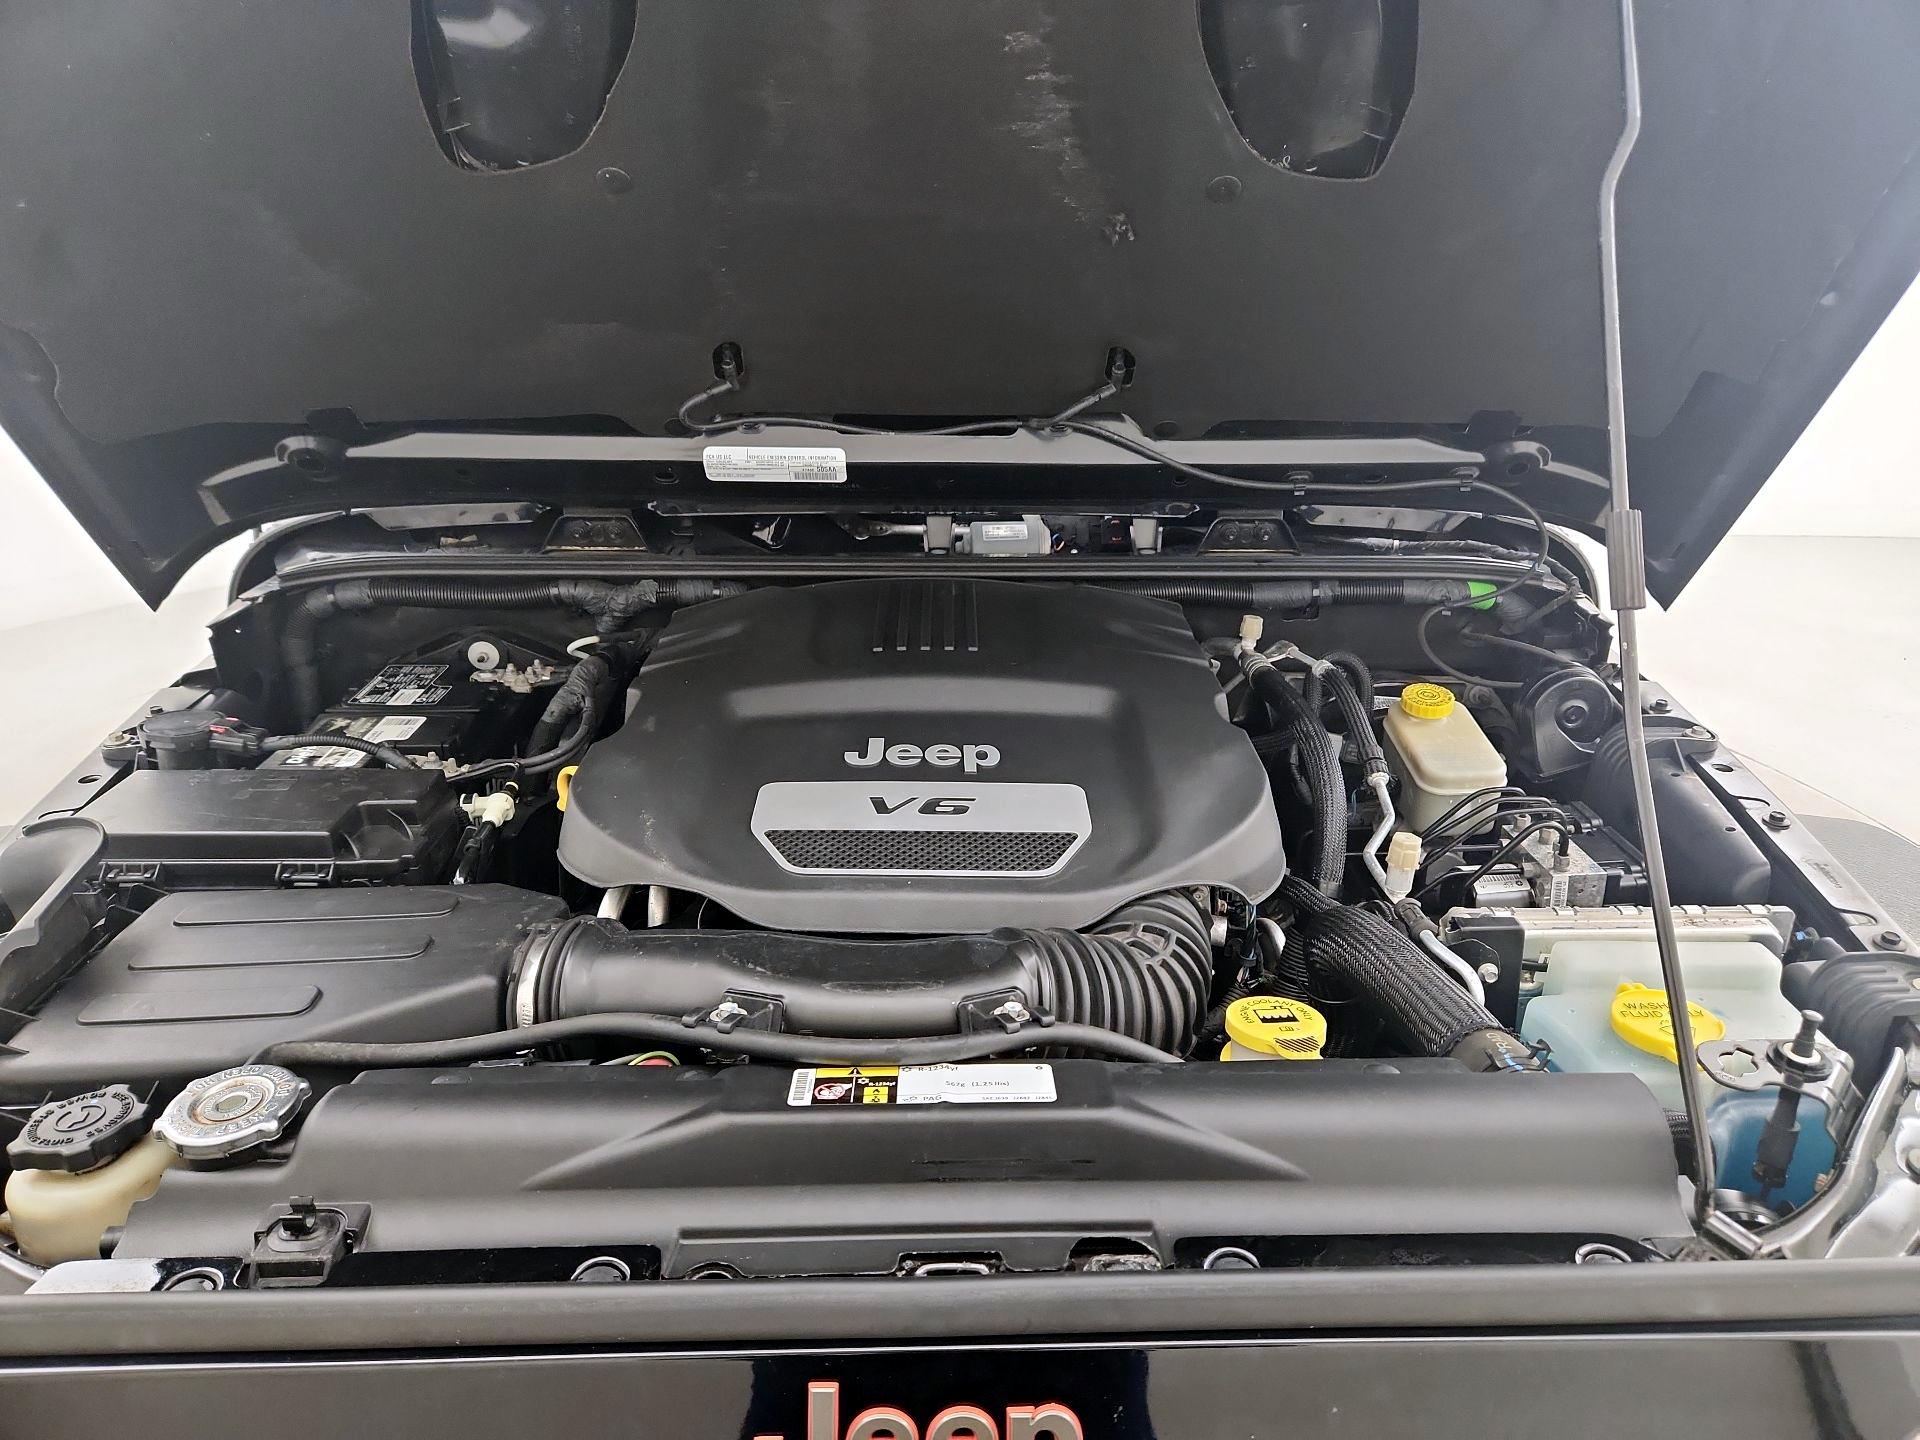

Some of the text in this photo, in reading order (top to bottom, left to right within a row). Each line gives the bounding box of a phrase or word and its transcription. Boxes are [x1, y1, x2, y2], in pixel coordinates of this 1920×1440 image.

[844, 737, 1001, 774] Jeep
[869, 796, 977, 816] V6
[1239, 999, 1313, 1024] ENGINE COOLANT ONLY
[1622, 1001, 1669, 1010] WASH
[1620, 1010, 1664, 1018] FLUID
[221, 1065, 261, 1080] OPEN
[918, 1064, 959, 1072] R-1234yf
[57, 1091, 107, 1109] POWER
[38, 1137, 74, 1146] FLUID
